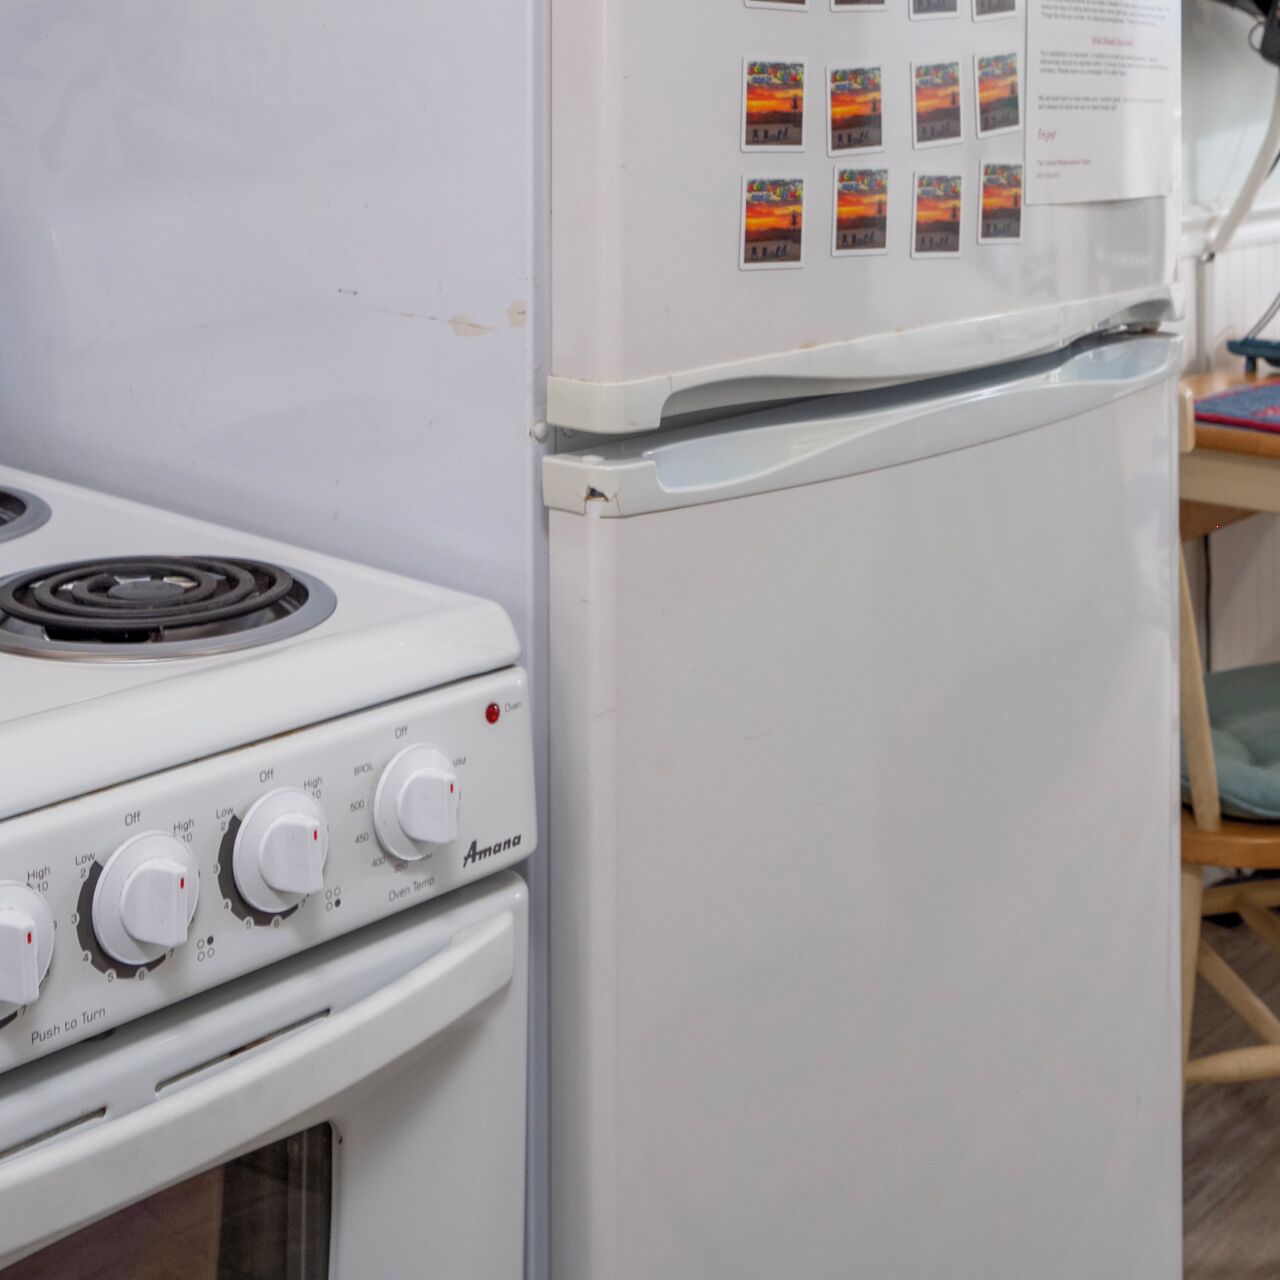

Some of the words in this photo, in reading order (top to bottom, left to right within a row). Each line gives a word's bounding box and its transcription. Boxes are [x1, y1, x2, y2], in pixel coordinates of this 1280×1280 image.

[504, 702, 522, 713] Oven
[395, 725, 408, 739] Off
[259, 768, 274, 784] Off
[353, 763, 373, 777] BROIL
[304, 776, 323, 791] High
[216, 806, 234, 820] Low
[350, 800, 365, 813] 500
[124, 810, 141, 827] Off
[173, 819, 195, 834] High
[221, 822, 226, 831] 2
[354, 832, 369, 845] 450
[463, 834, 522, 869] Amana
[75, 851, 95, 866] Low
[371, 857, 386, 869] 400
[27, 865, 51, 882] High
[80, 868, 87, 879] 2
[213, 864, 219, 874] 3
[37, 882, 49, 893] 10
[389, 886, 410, 902] Oven
[413, 876, 435, 893] Temp
[223, 901, 229, 910] 4
[71, 914, 78, 925] 3
[246, 920, 252, 930] 5
[82, 953, 89, 963] 4
[107, 972, 114, 983] 5
[138, 971, 145, 982] 6
[31, 1027, 61, 1049] Push
[64, 1019, 78, 1031] to
[81, 1007, 106, 1024] Turn
